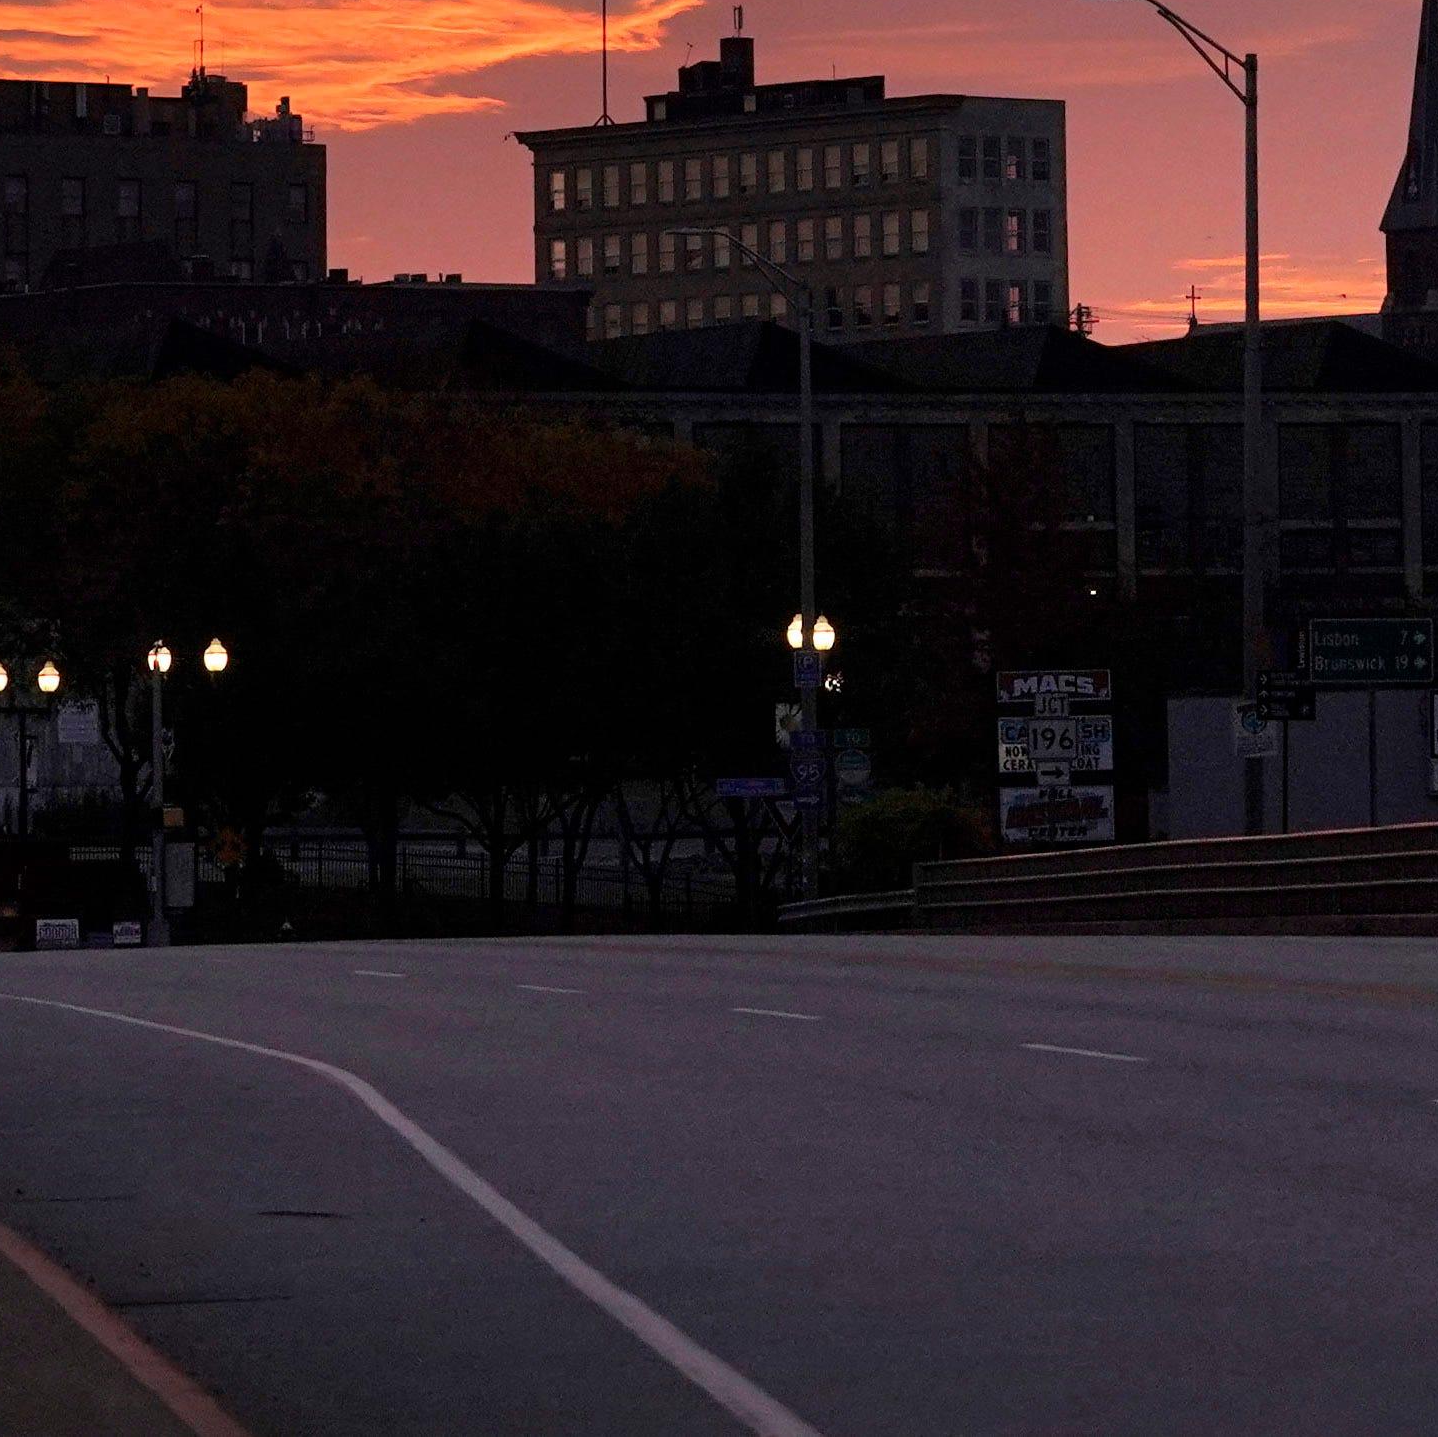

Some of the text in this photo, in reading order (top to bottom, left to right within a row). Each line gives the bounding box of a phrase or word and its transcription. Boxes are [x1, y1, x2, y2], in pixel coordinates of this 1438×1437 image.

[1314, 630, 1408, 646] Lisbon 7
[1314, 654, 1409, 671] Brunswick 19
[1012, 675, 1095, 697] MACS
[1037, 696, 1067, 714] JCT
[1032, 728, 1074, 750] 196
[796, 764, 819, 781] 95
